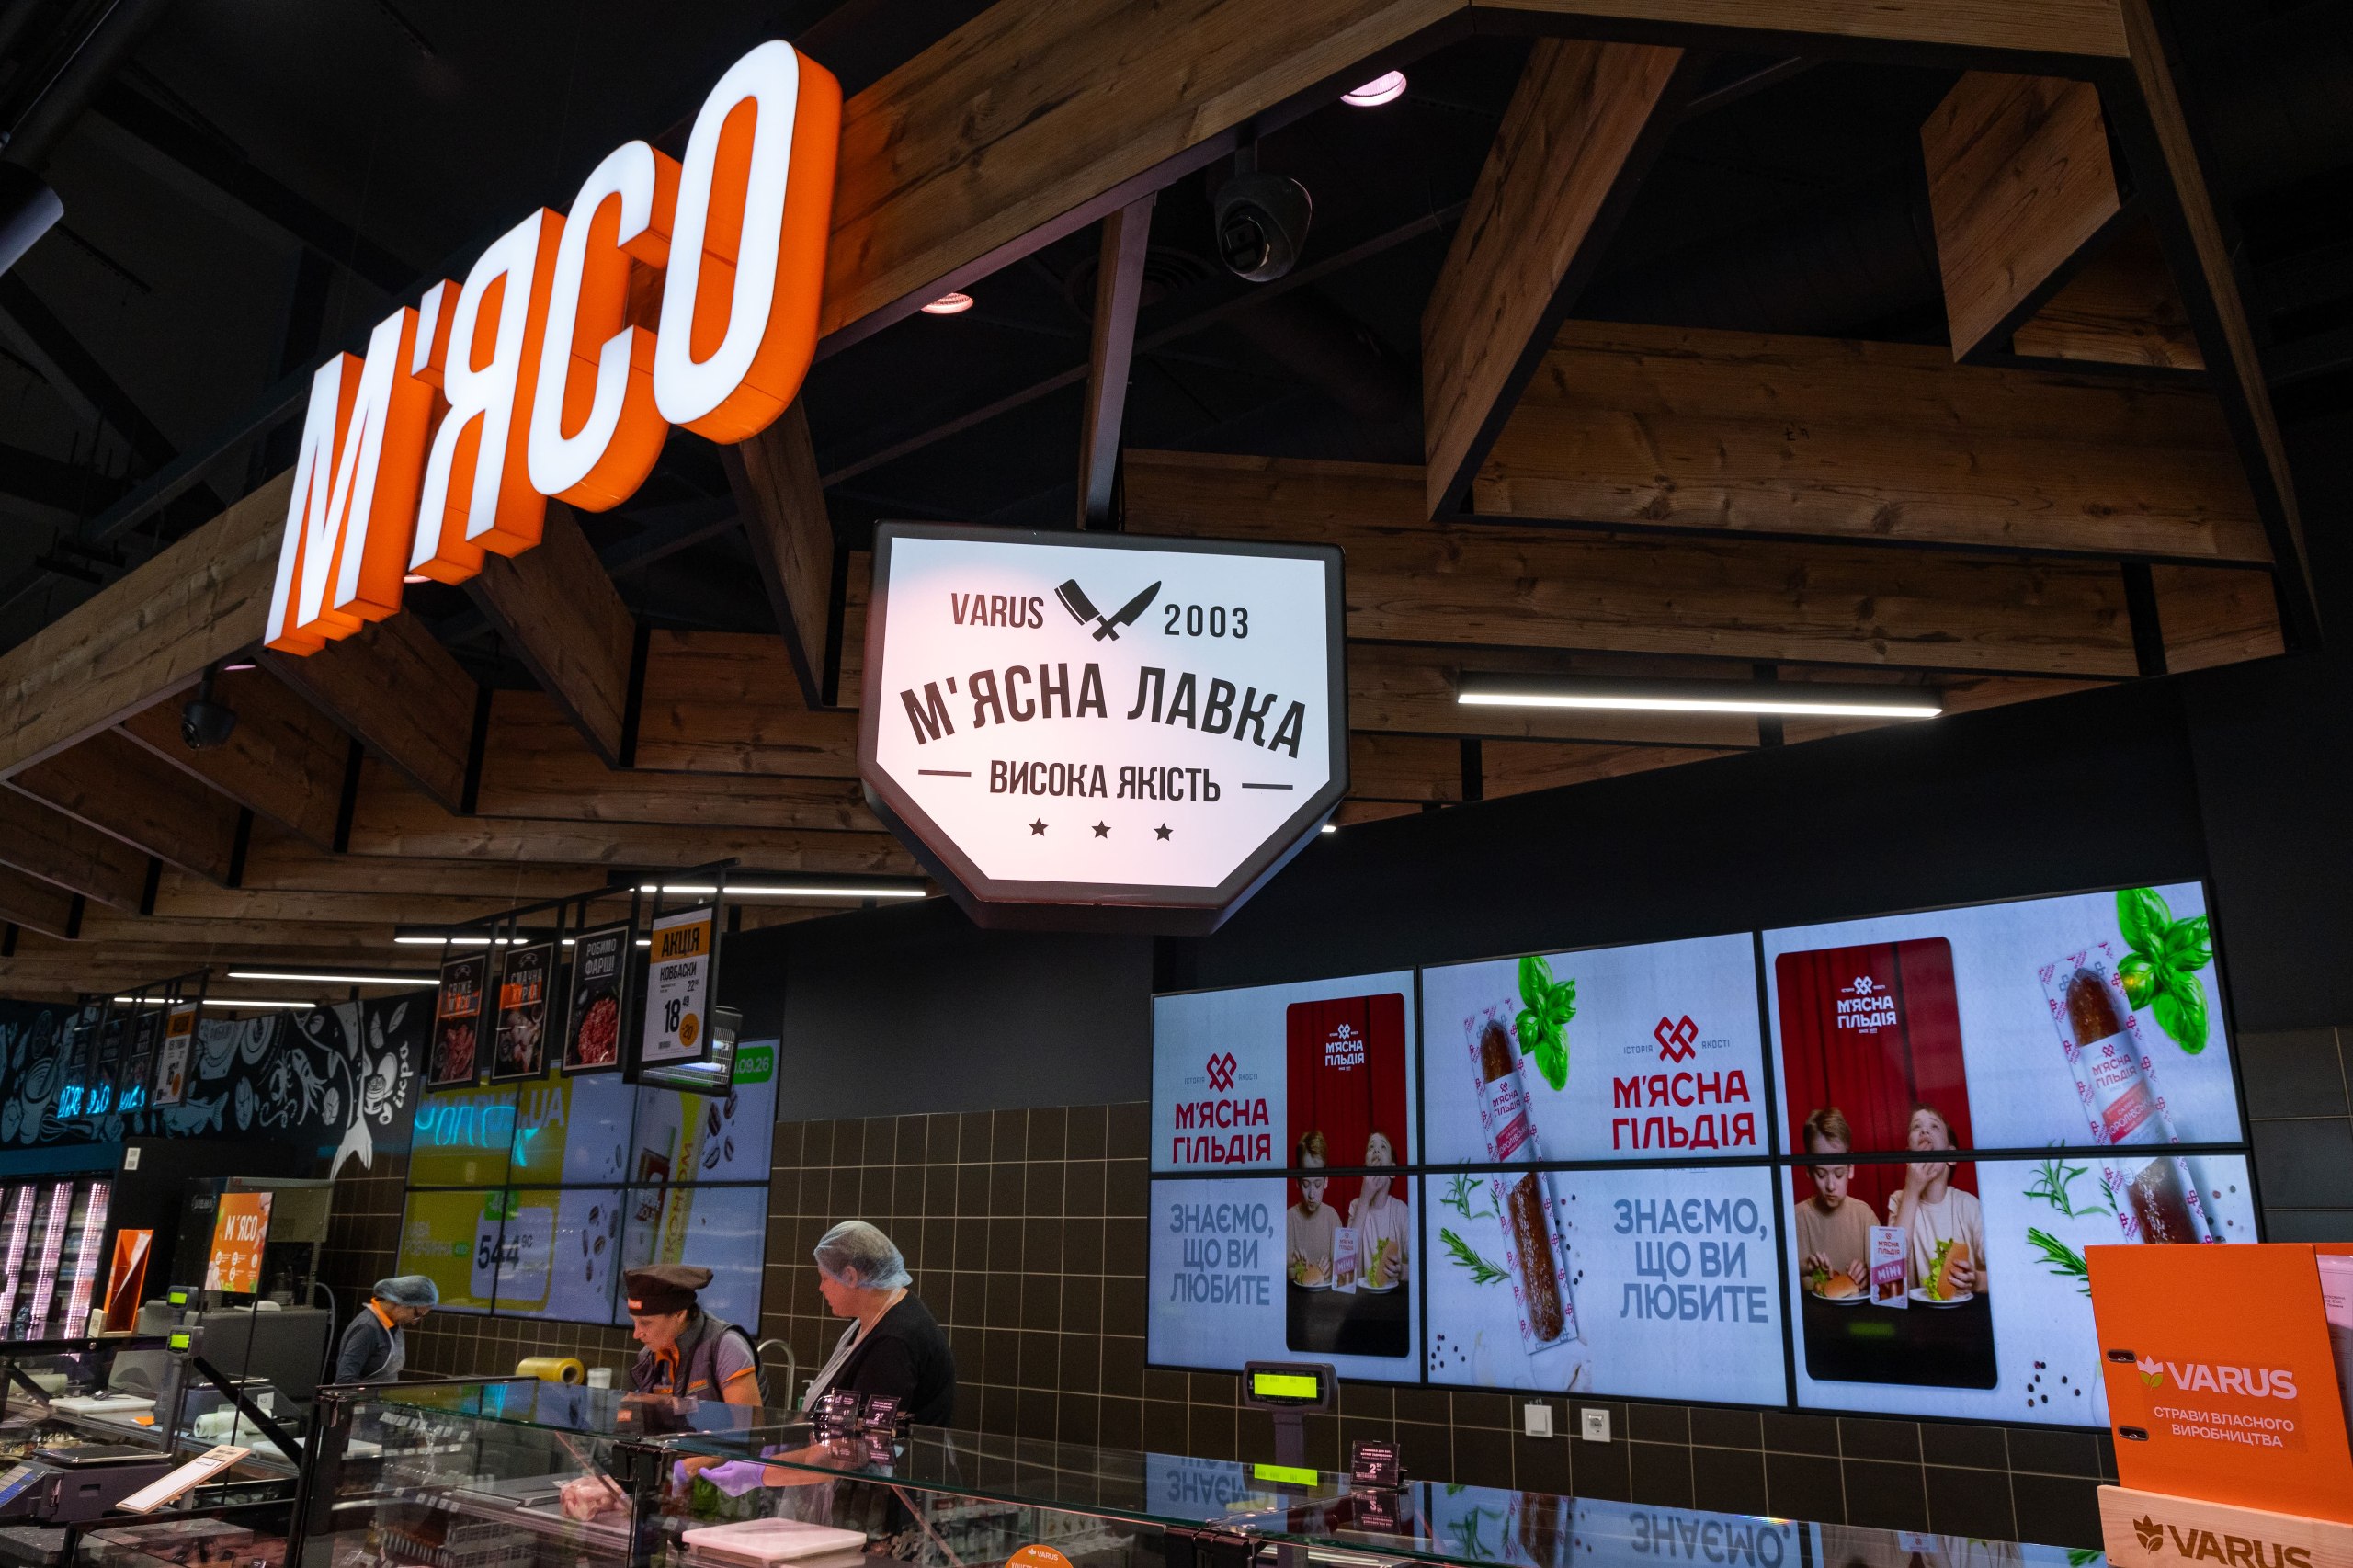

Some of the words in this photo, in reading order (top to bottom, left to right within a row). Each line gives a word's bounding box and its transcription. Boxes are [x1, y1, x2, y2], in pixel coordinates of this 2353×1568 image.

[264, 40, 818, 649] М'ЯСО
[950, 593, 1044, 630] VARUS
[1164, 603, 1249, 639] 2003
[900, 663, 1108, 745] М'ЯСНА
[1127, 665, 1306, 759] ЛАВКА
[990, 759, 1108, 799] ВИСОКА
[1117, 765, 1221, 802] ЯКІСТЬ
[586, 938, 617, 958] РОБИМО
[661, 926, 700, 957] АКЦІЯ
[510, 968, 543, 986] СМАЧНА
[585, 955, 614, 975] ФАРШ!
[659, 962, 698, 982] КОВБАСКИ
[665, 998, 681, 1033] 18
[1837, 995, 1894, 1013] М'ЯСНА
[1837, 1011, 1897, 1028] ГІЛЬДІЯ
[1324, 1052, 1365, 1067] ГІЛЬДІЯ
[1325, 1040, 1364, 1054] М'ЯСНА
[1623, 1044, 1654, 1054] ІСТОРІЯ
[1701, 1040, 1730, 1049] ЯКОСТІ
[2092, 1053, 2132, 1076] М'ЯСНА
[2096, 1065, 2138, 1089] ГІЛЬДІЯ
[1492, 1089, 1518, 1108] М'ЯСНА
[1613, 1069, 1751, 1108] М'ЯСНА
[1175, 1098, 1269, 1130] М'ЯСНА
[1612, 1112, 1756, 1150] ГІЛЬДІЯ
[1173, 1133, 1271, 1164] ГІЛЬДІЯ
[224, 1214, 258, 1242] М'ЯСО
[1169, 1202, 1274, 1239] ЗНАЄМО,
[1613, 1198, 1768, 1242] ЗНАЄМО,
[1183, 1238, 1222, 1273] ЩО
[1227, 1238, 1258, 1269] ВИ
[1635, 1241, 1691, 1282] ЩО
[1699, 1241, 1747, 1278] ВИ
[1170, 1273, 1270, 1306] ЛЮБИТЕ
[1620, 1283, 1768, 1324] ЛЮБИТЕ
[2165, 1361, 2297, 1400] VARUS
[2154, 1406, 2208, 1425] СТРАВИ
[2211, 1412, 2294, 1432] ВЛАСНОГО
[2171, 1424, 2283, 1448] ВИРОБНИЦТВА
[1370, 1463, 1376, 1474] 2
[1037, 1551, 1059, 1561] VARUS
[2166, 1524, 2313, 1568] VARUS
